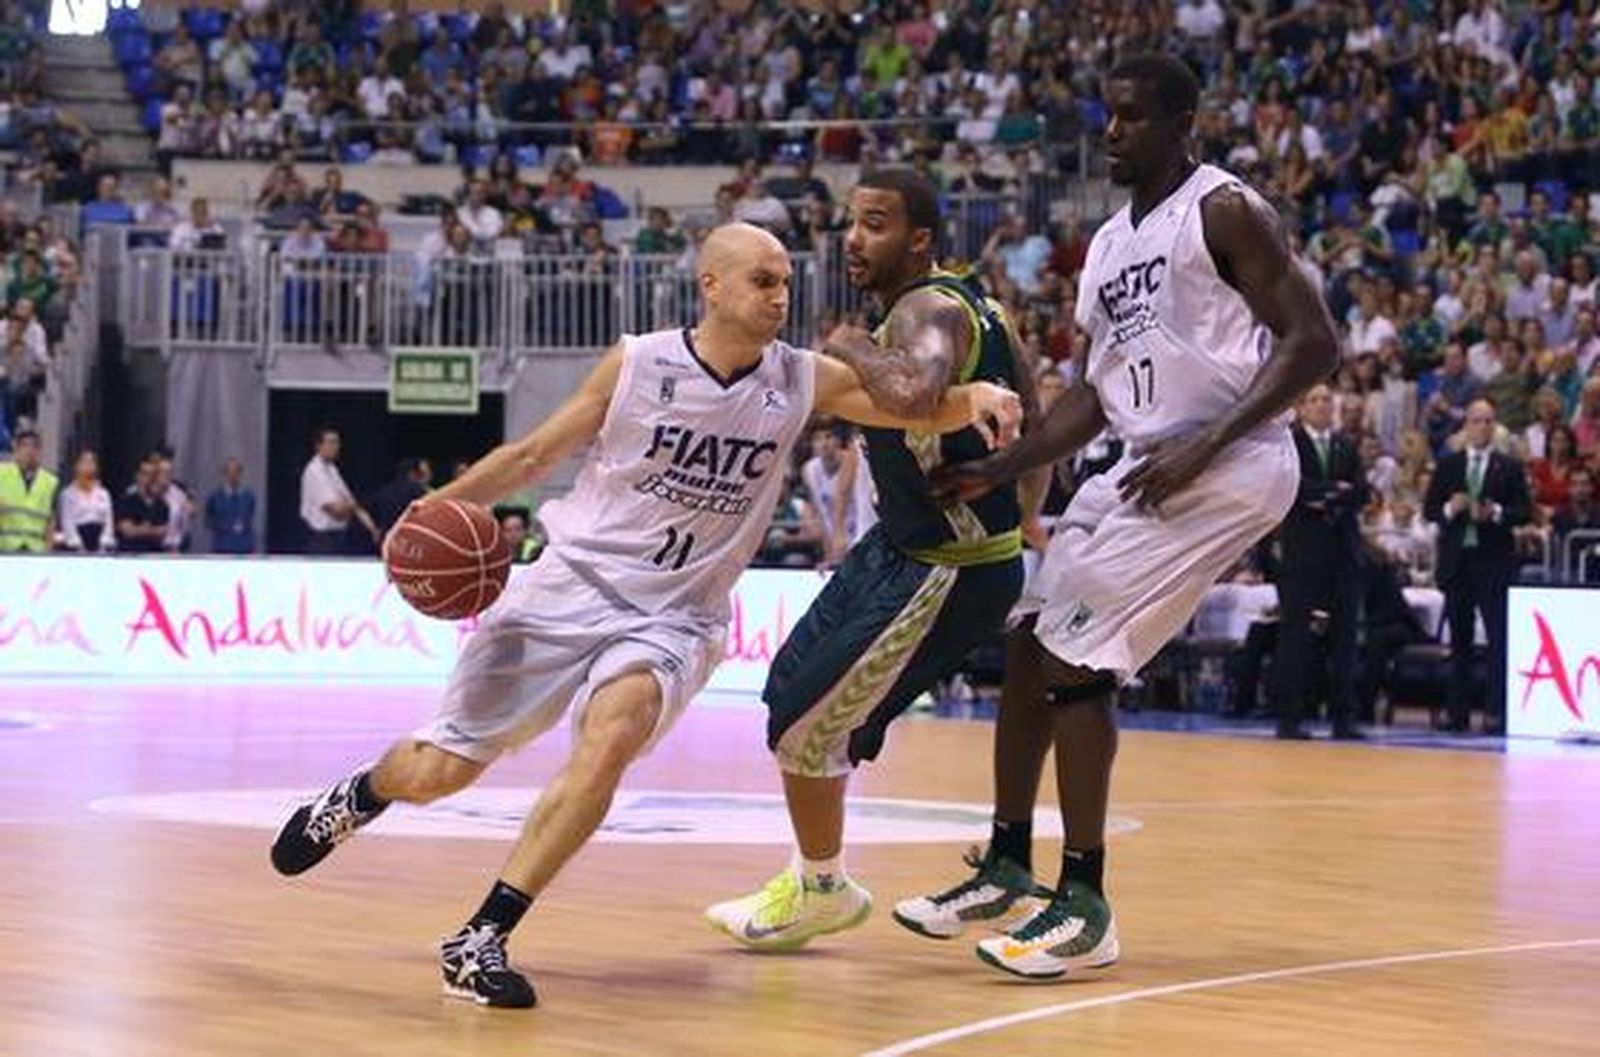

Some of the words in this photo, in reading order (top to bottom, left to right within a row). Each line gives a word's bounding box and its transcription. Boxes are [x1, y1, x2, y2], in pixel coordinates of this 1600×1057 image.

[1128, 356, 1155, 409] 17
[643, 424, 778, 480] FIATC
[652, 525, 695, 571] 11
